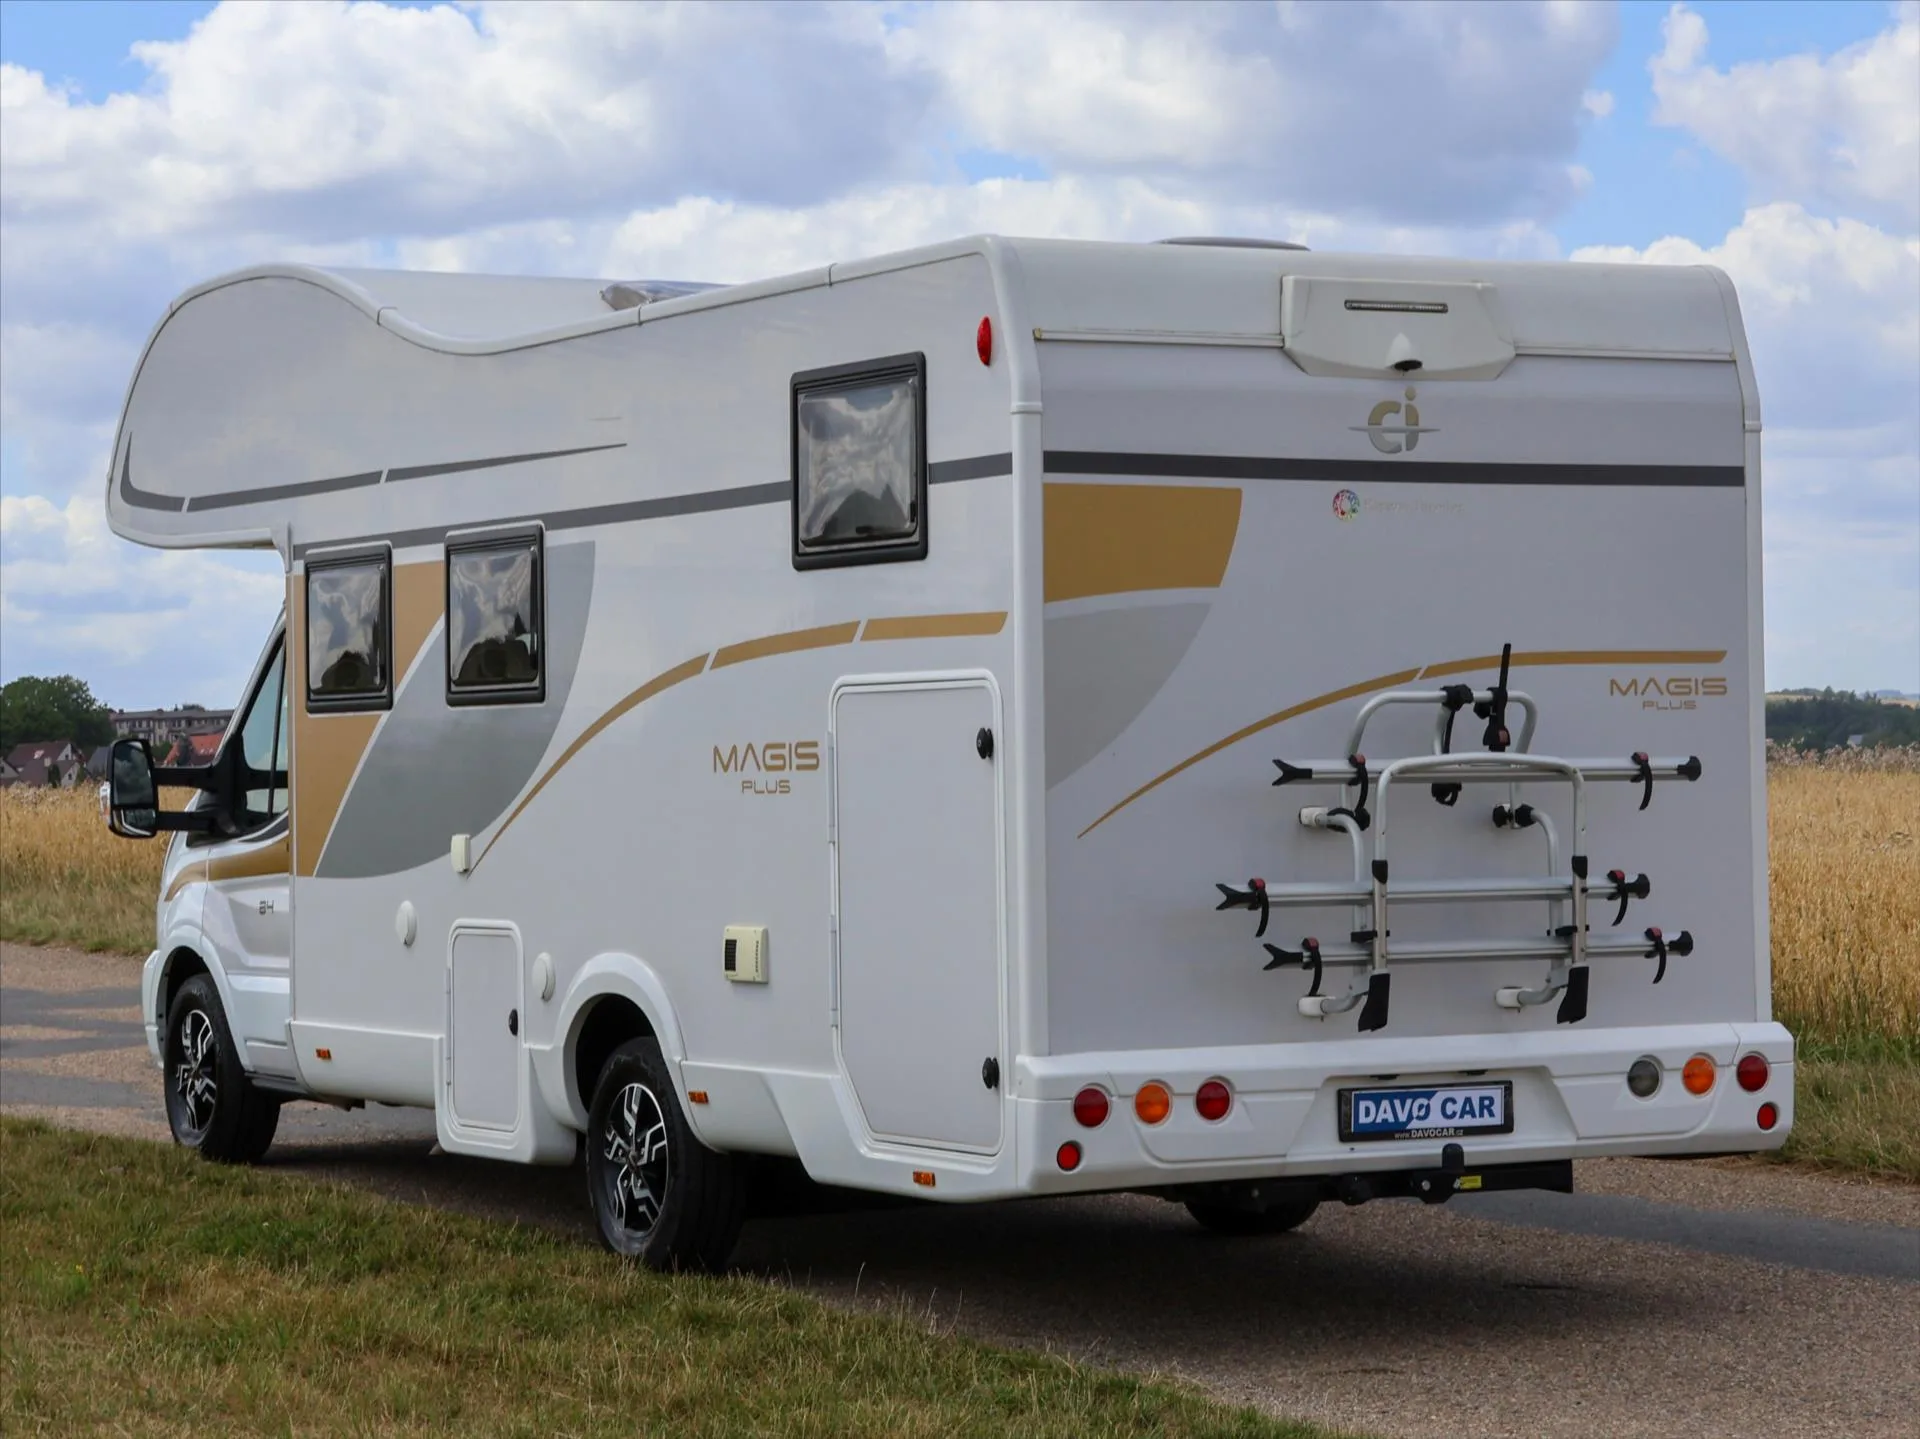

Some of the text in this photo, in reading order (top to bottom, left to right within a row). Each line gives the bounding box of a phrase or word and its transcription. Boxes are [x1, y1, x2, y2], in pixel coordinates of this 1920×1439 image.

[1609, 677, 1728, 697] MAGIS
[1642, 699, 1697, 711] PLUS
[713, 741, 820, 773] MAGIS
[741, 779, 791, 794] PLUS
[1358, 1095, 1496, 1124] DAVO CAR
